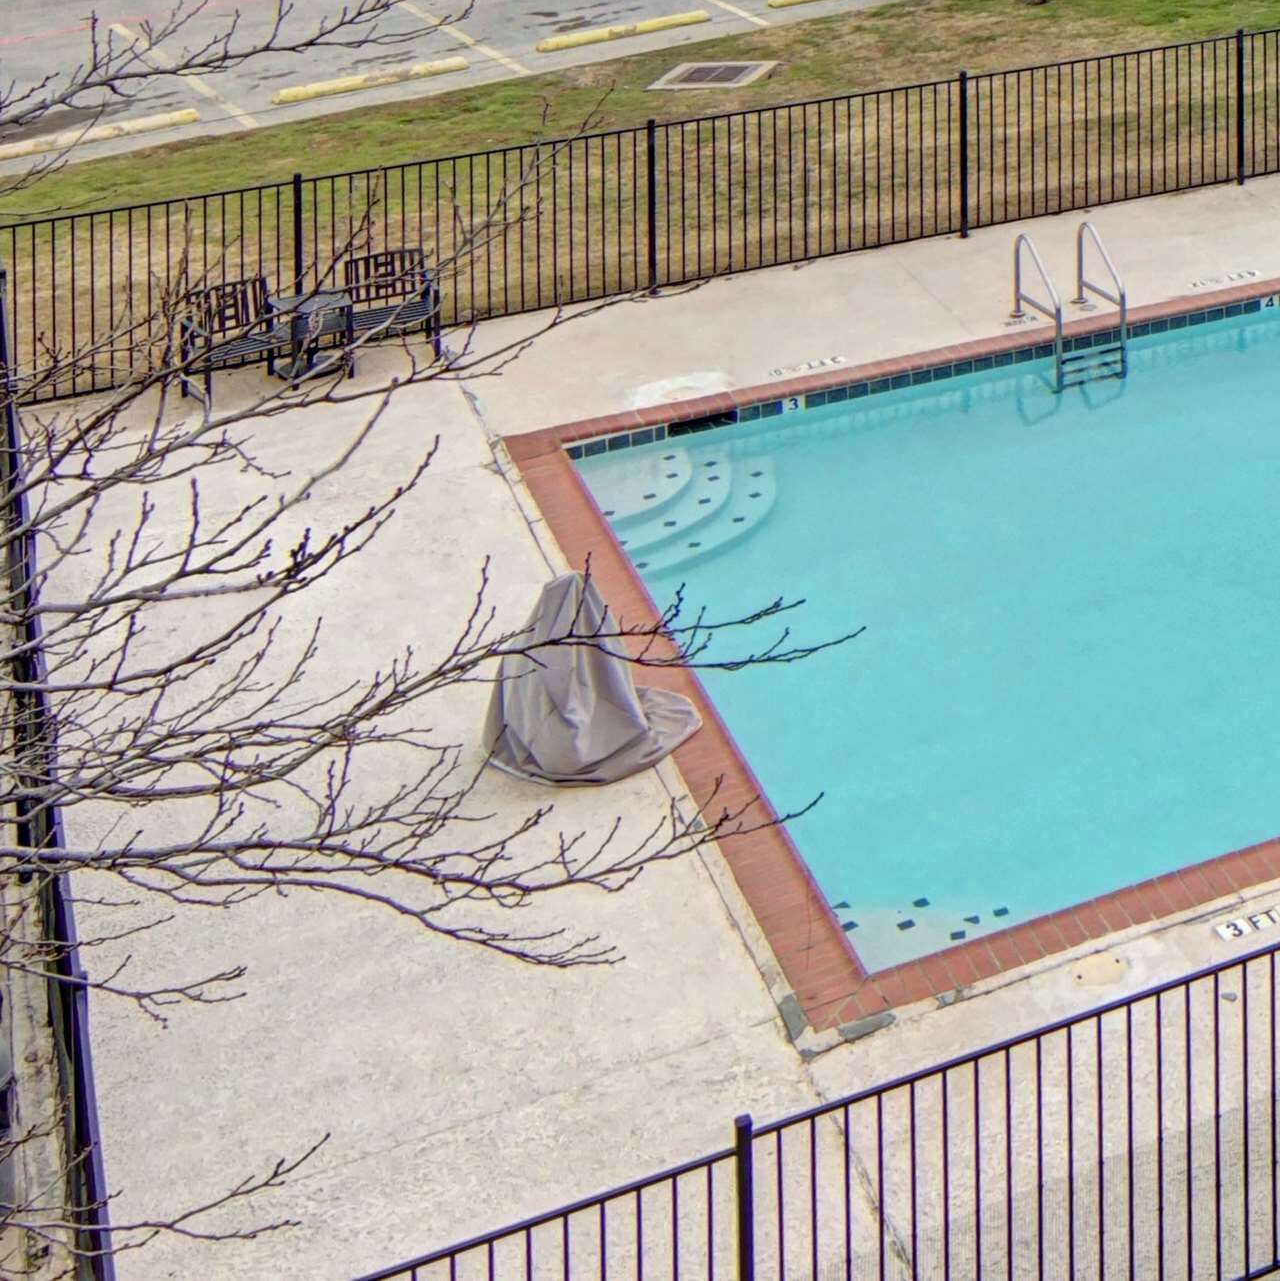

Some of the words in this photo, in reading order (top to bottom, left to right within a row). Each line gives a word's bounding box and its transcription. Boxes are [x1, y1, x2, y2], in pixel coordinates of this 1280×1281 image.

[1264, 294, 1275, 307] 4
[788, 397, 799, 411] 3
[1226, 921, 1244, 938] 3
[1247, 909, 1277, 931] FT
